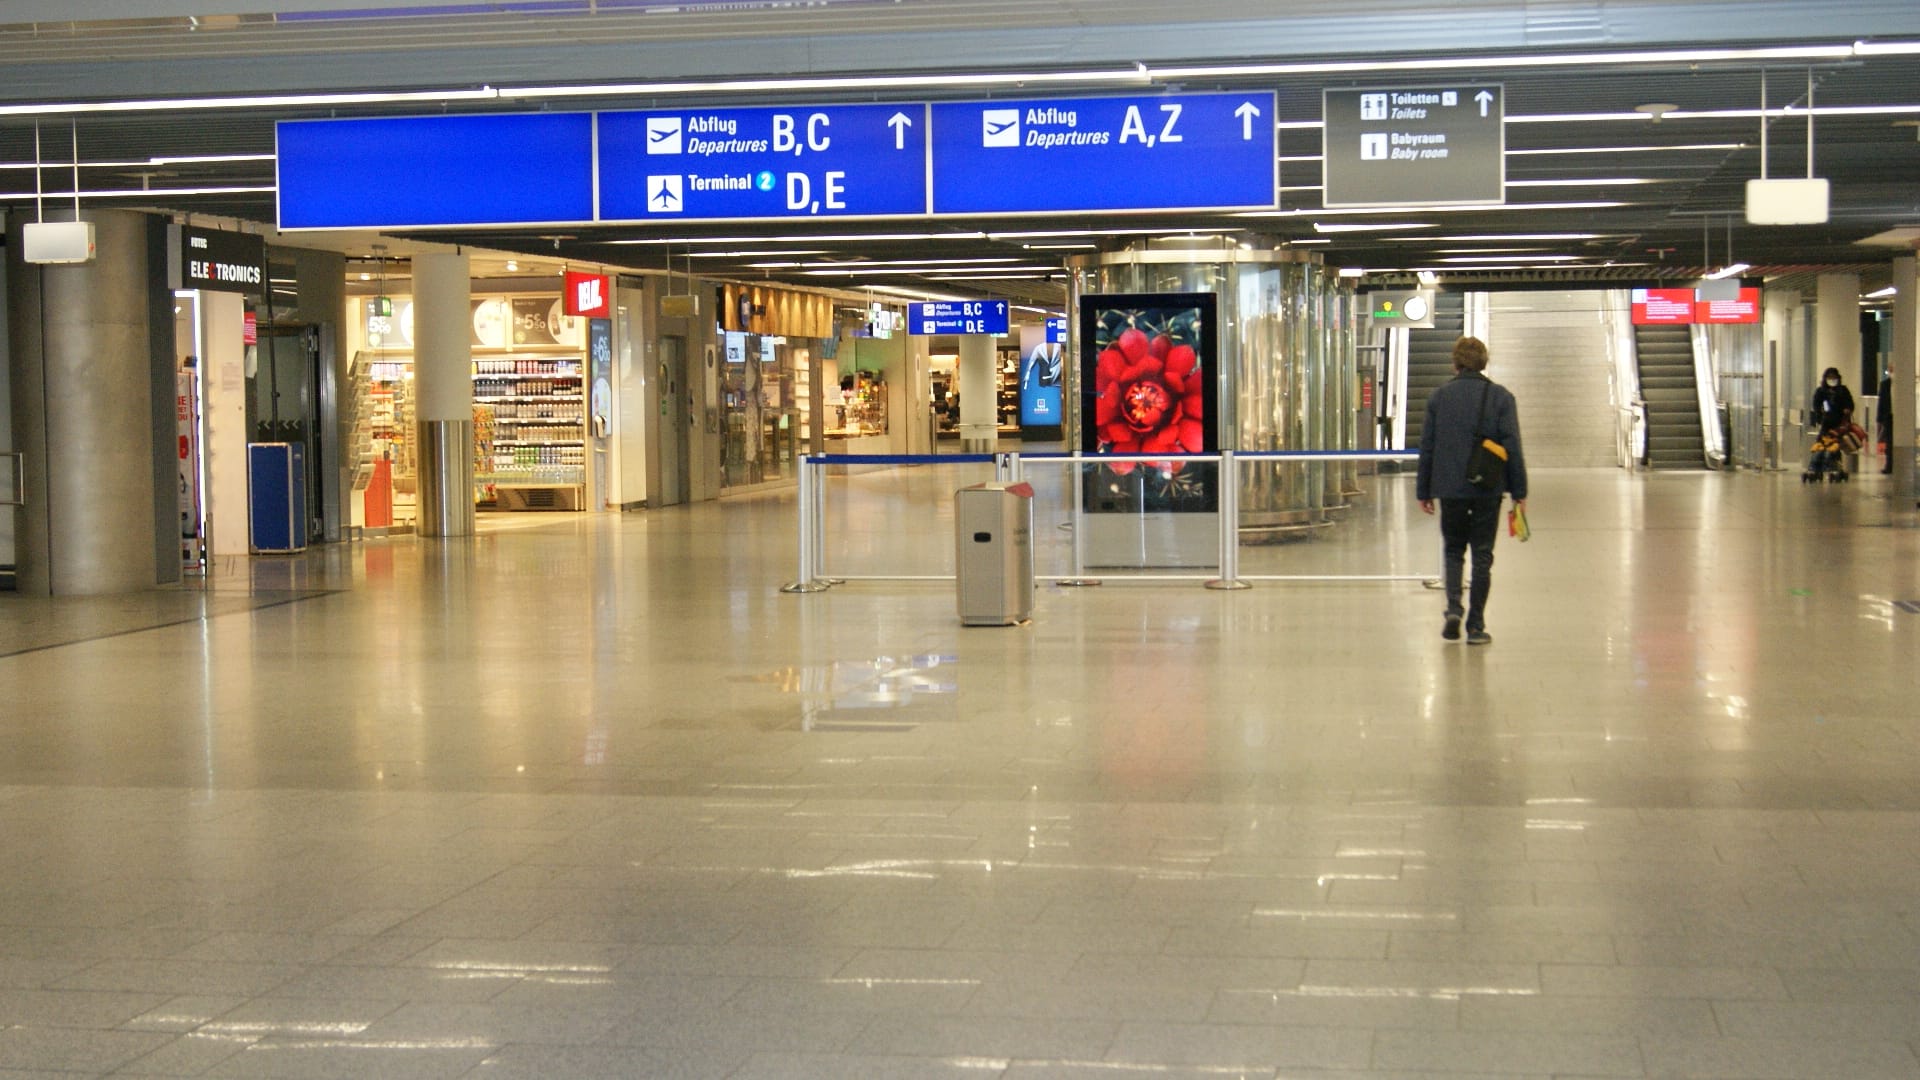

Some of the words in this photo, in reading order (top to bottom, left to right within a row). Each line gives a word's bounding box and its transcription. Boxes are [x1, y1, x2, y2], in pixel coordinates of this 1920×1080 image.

[1390, 92, 1440, 105] Toiletten
[1025, 107, 1078, 127] Abflug
[1390, 107, 1427, 119] Toilets
[687, 115, 737, 135] Abflug
[772, 112, 831, 156] B,C
[1119, 103, 1183, 148] A,Z
[687, 137, 768, 157] Departures
[1025, 129, 1110, 149] Departures
[1390, 132, 1446, 146] Babyraum
[1390, 147, 1419, 161] Baby
[1420, 149, 1449, 159] room
[687, 173, 752, 191] Terminal
[757, 172, 773, 190] 2
[786, 171, 846, 214] D,E
[190, 260, 261, 284] ELECTRONICS
[963, 302, 983, 317] B,C
[965, 319, 985, 334] D,E
